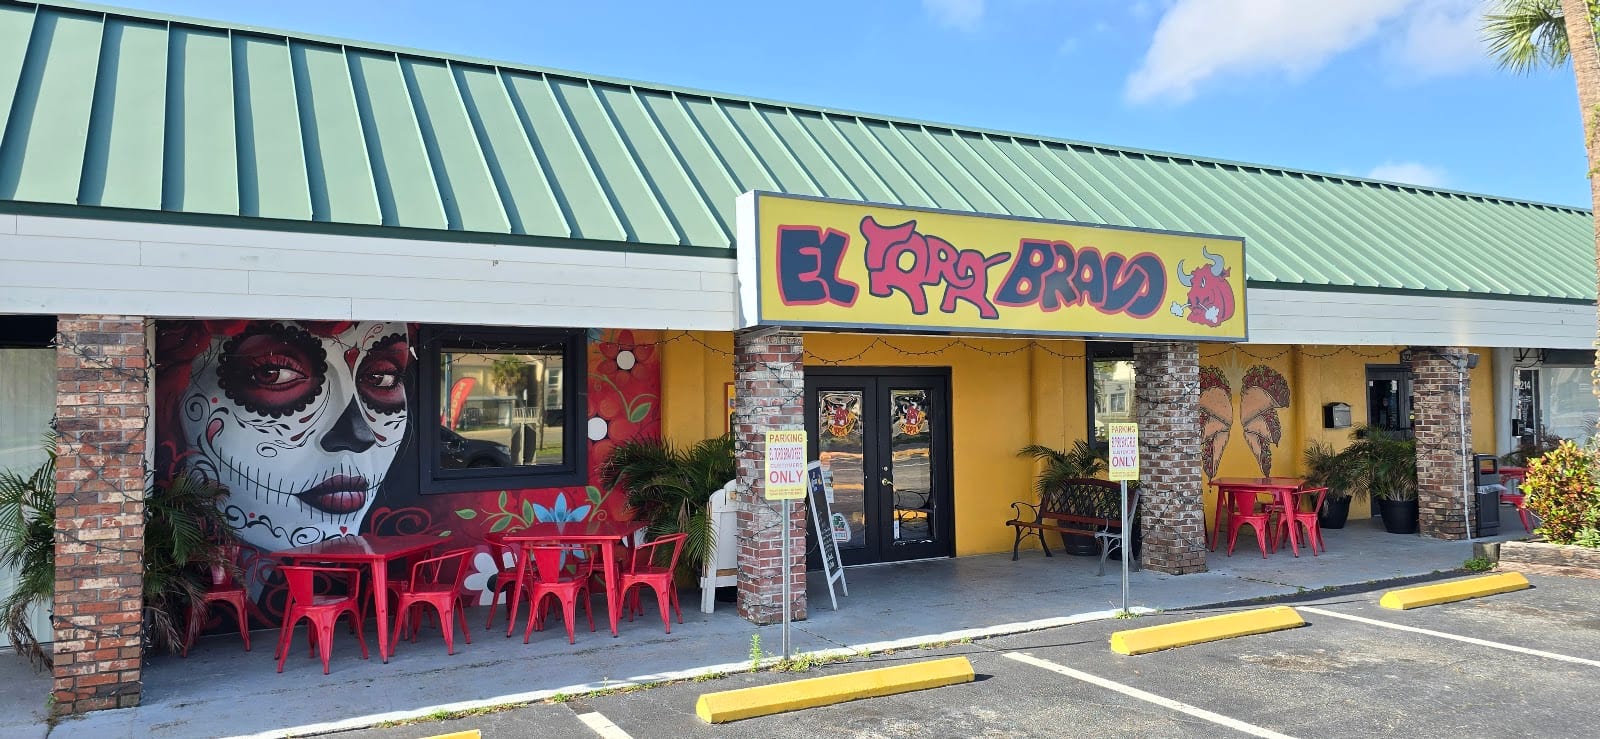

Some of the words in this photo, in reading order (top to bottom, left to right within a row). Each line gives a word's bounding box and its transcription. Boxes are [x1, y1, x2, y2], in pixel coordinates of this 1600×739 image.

[776, 223, 859, 309] EL
[859, 215, 1012, 320] TORO
[993, 237, 1168, 320] BRAVO
[1519, 381, 1531, 389] 214
[769, 434, 803, 443] PARKING
[1112, 456, 1136, 467] ONLY
[769, 471, 803, 484] ONLY
